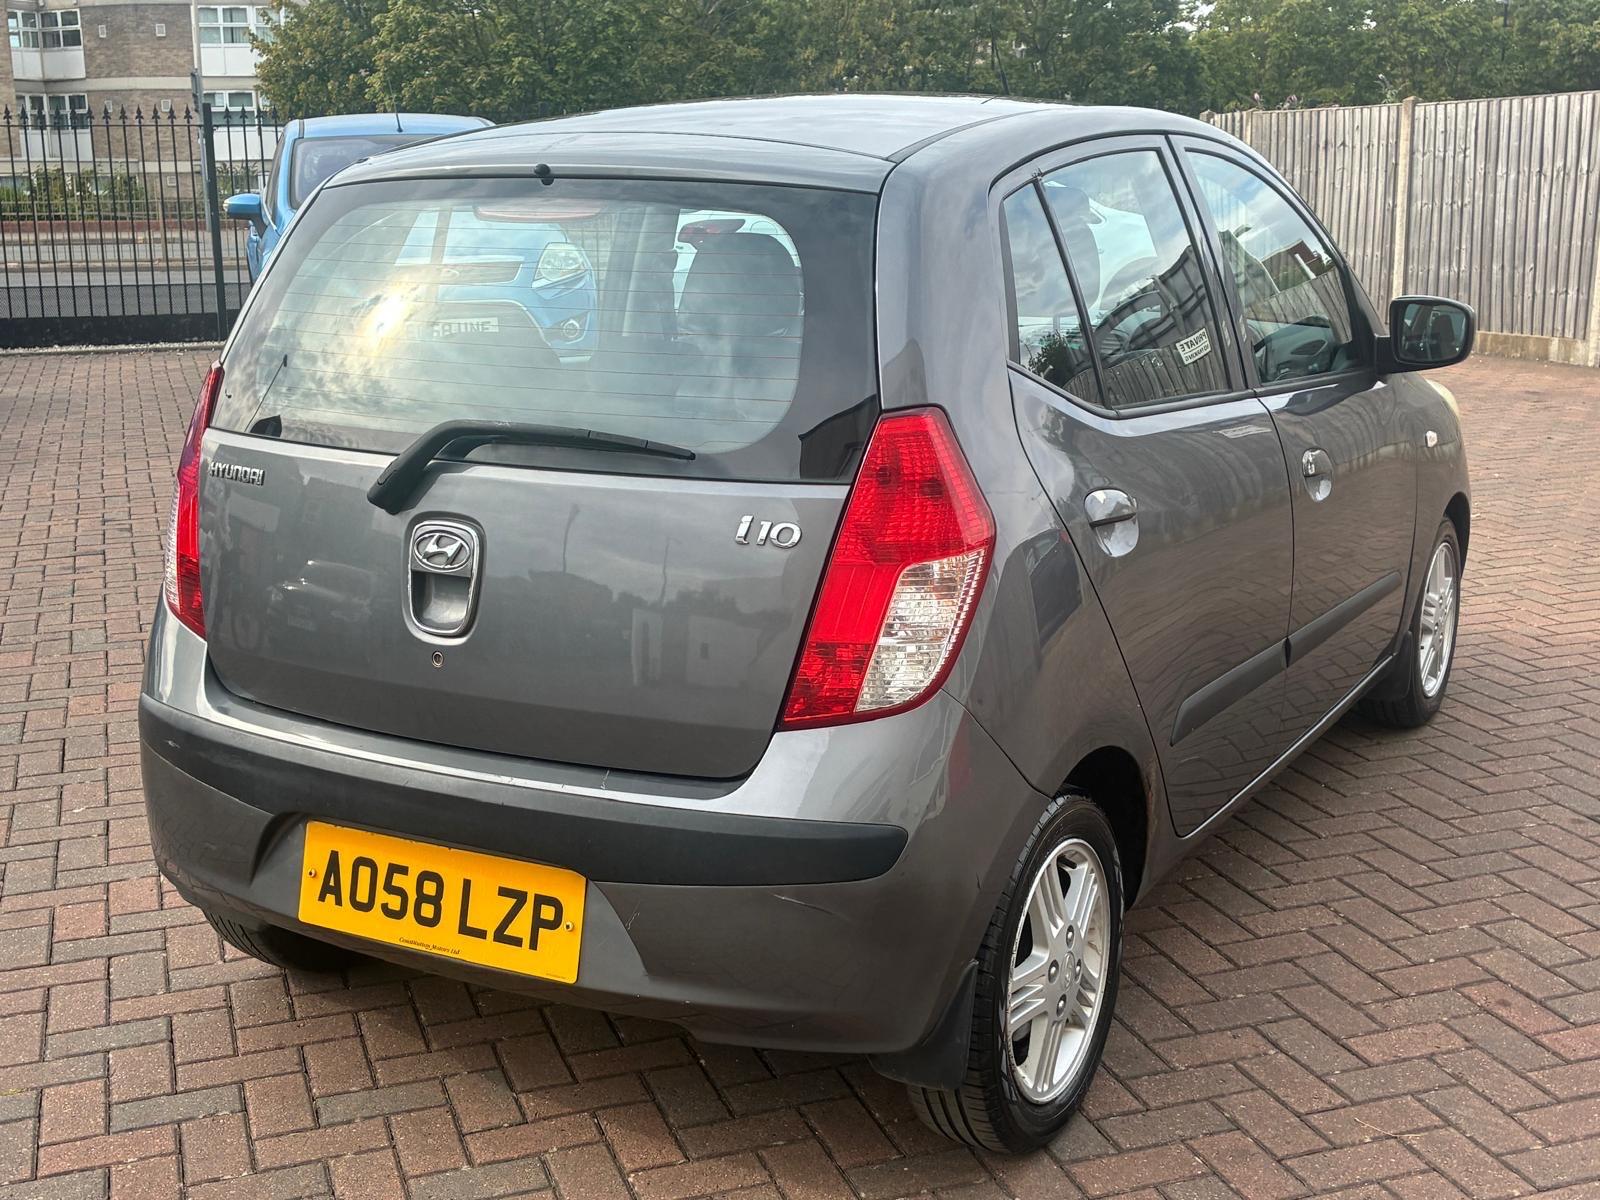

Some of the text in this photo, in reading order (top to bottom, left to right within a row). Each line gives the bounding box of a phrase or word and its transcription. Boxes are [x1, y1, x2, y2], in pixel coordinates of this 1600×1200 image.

[209, 461, 265, 486] HYUNDAI
[317, 850, 564, 951] AO58 LZP
